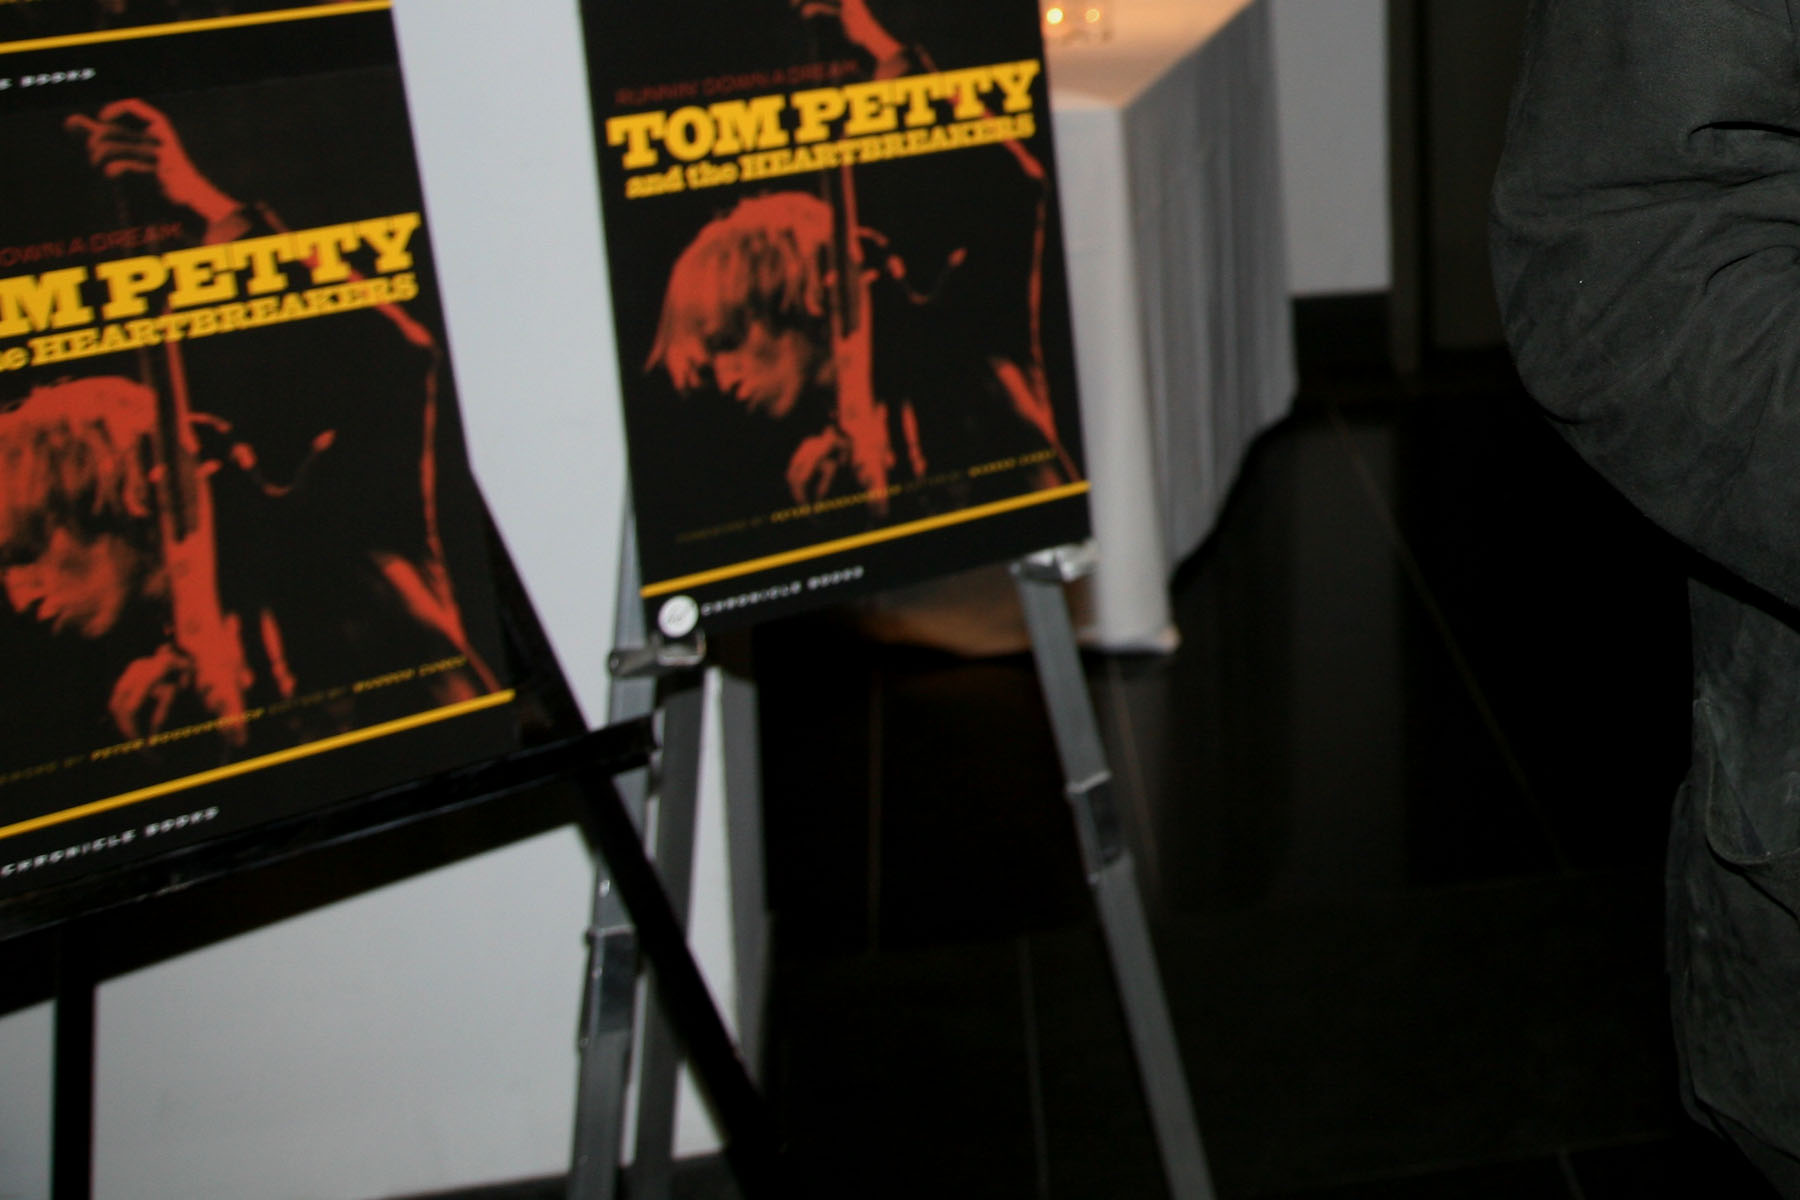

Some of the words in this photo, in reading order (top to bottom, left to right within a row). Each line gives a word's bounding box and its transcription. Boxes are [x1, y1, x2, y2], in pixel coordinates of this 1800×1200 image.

[606, 93, 790, 170] TOM
[790, 59, 1041, 145] PETTY
[624, 163, 686, 200] and
[686, 160, 740, 190] the
[738, 112, 1036, 183] HEARTBREAKERS
[94, 211, 421, 321] PETTY
[27, 271, 419, 367] HEARTBREAKERS
